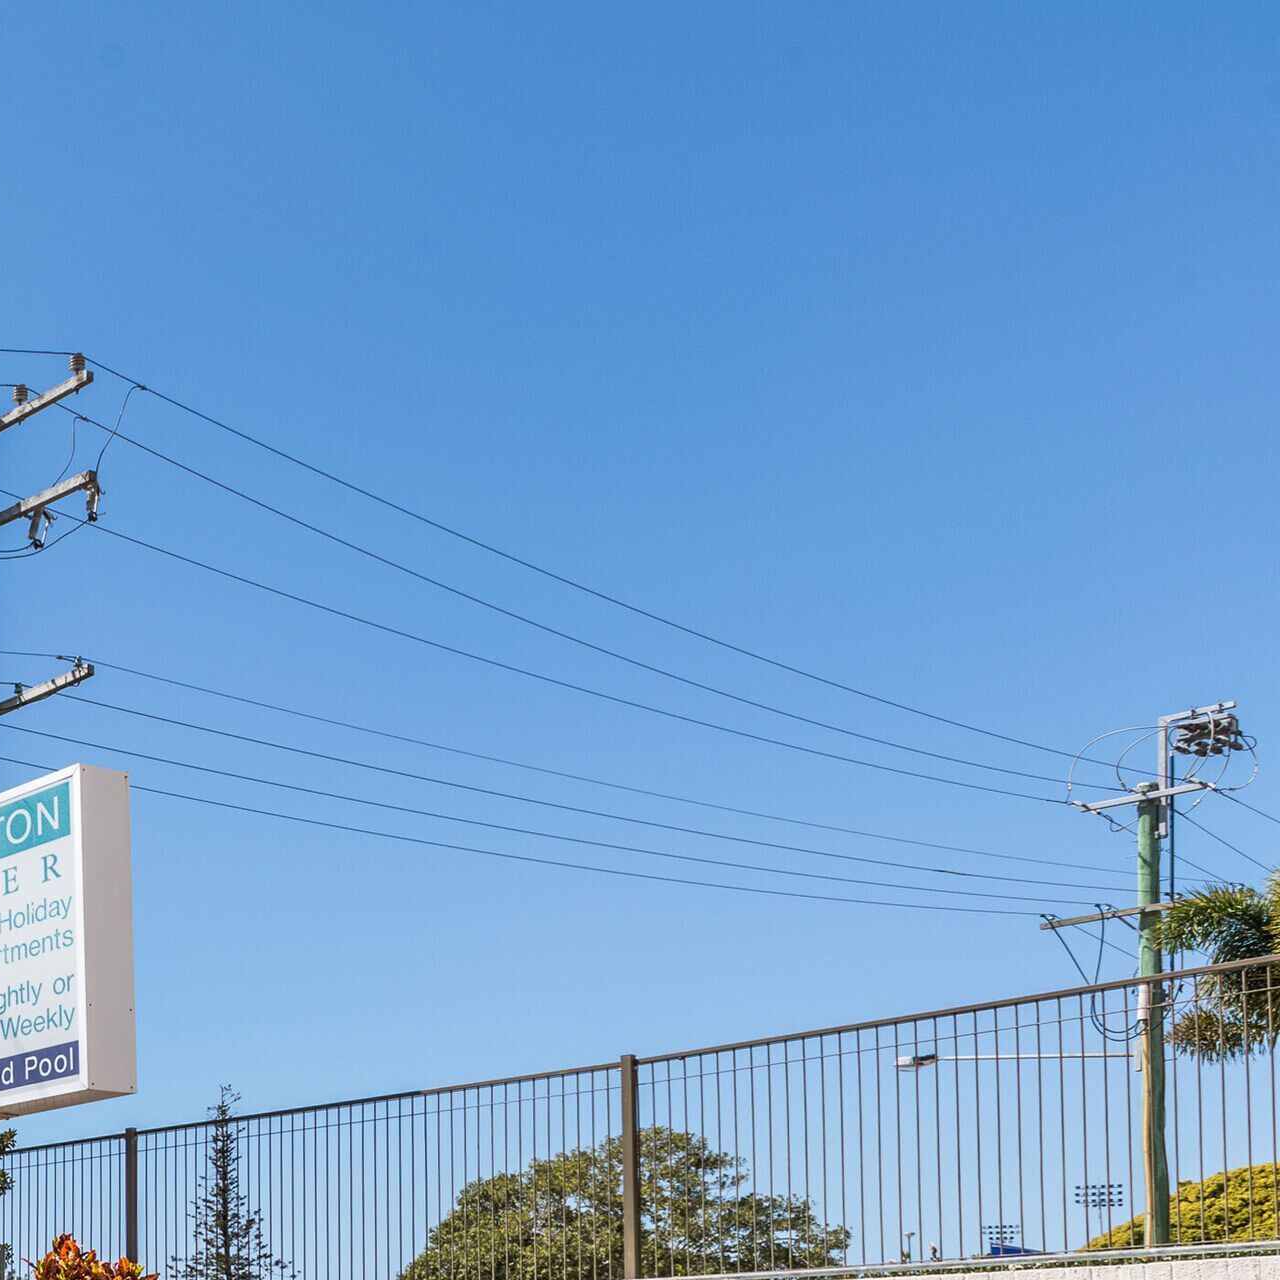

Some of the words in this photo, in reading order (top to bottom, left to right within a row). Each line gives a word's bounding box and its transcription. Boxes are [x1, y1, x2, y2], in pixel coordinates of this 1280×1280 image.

[52, 973, 75, 995] or
[0, 1004, 76, 1041] Weekly
[24, 1047, 74, 1080] Pool
